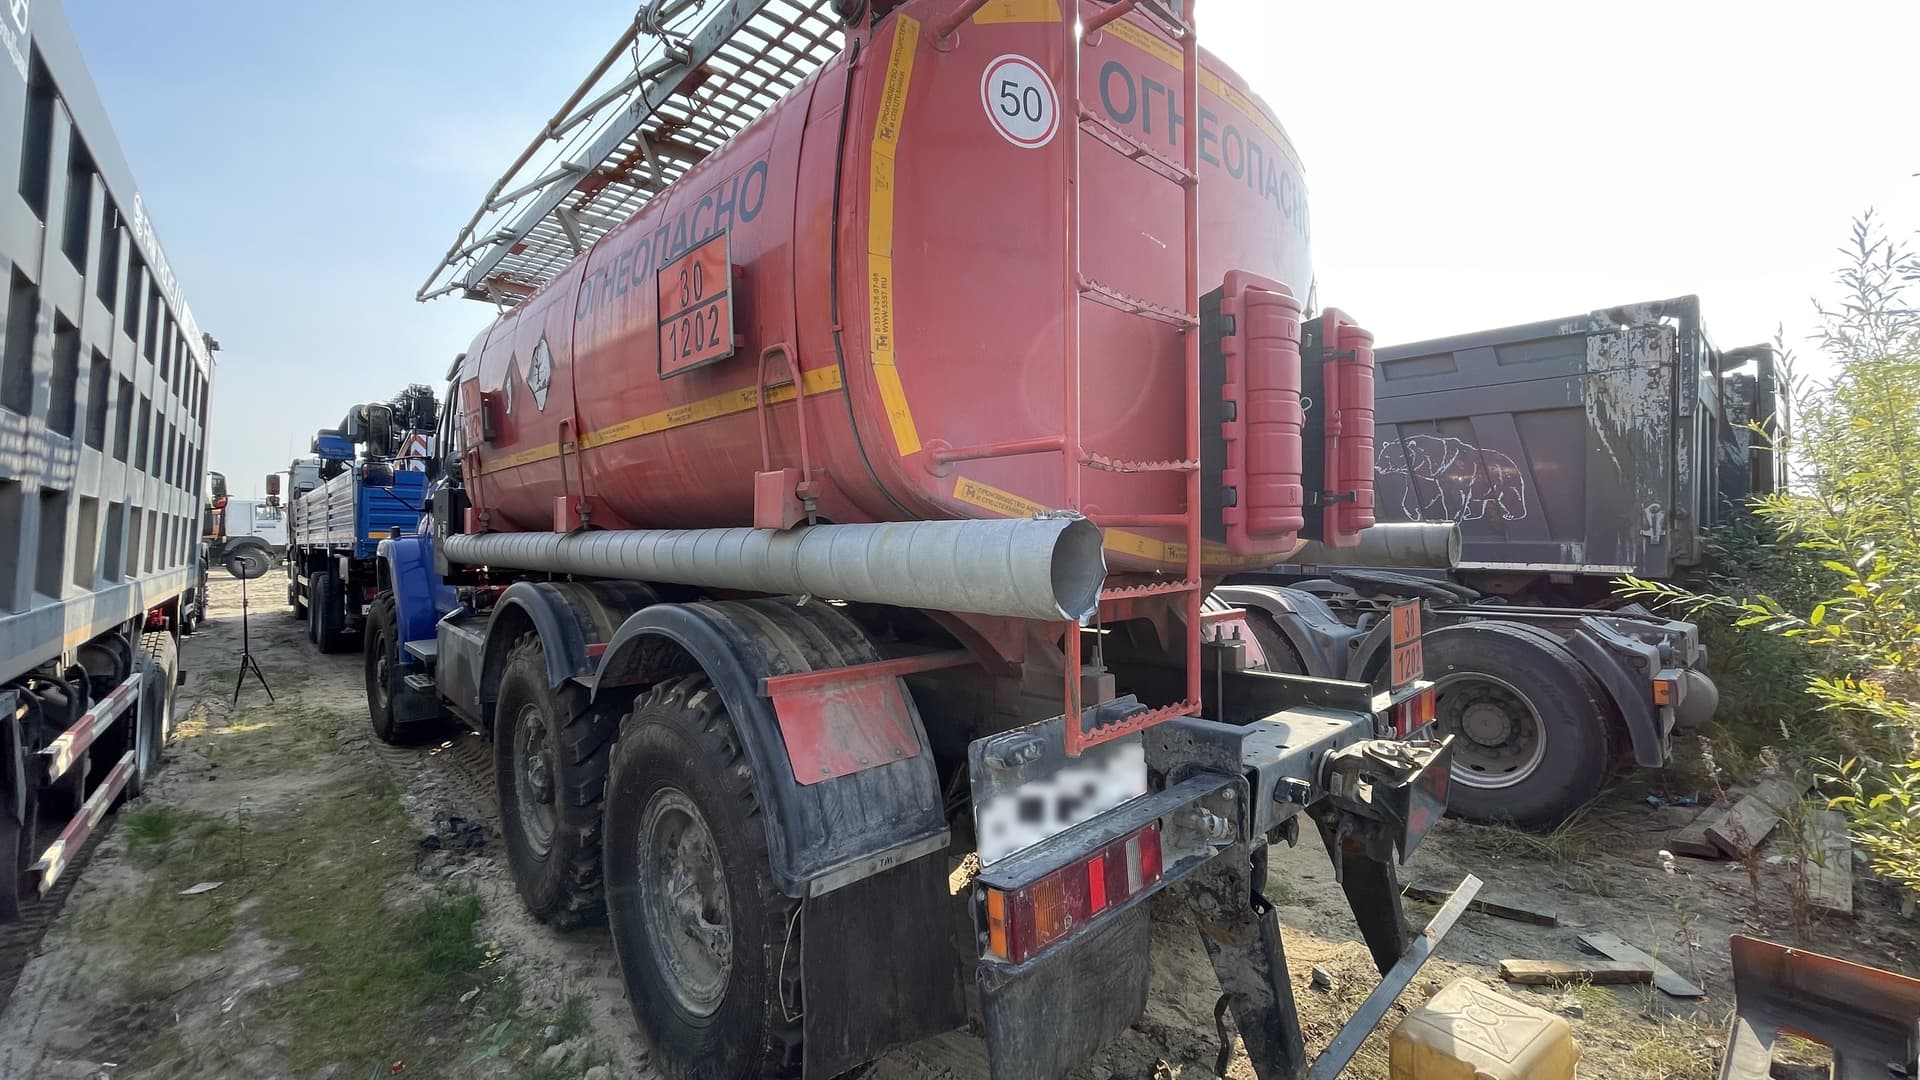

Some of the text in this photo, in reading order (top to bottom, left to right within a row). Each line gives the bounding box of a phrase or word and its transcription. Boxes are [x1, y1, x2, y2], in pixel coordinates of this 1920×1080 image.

[1000, 79, 1043, 122] 50
[576, 159, 768, 321] ОГНЕОПАСНО
[679, 260, 704, 308] 30
[668, 305, 720, 363] 1202
[1405, 607, 1415, 638] 30
[1399, 645, 1420, 680] 1202
